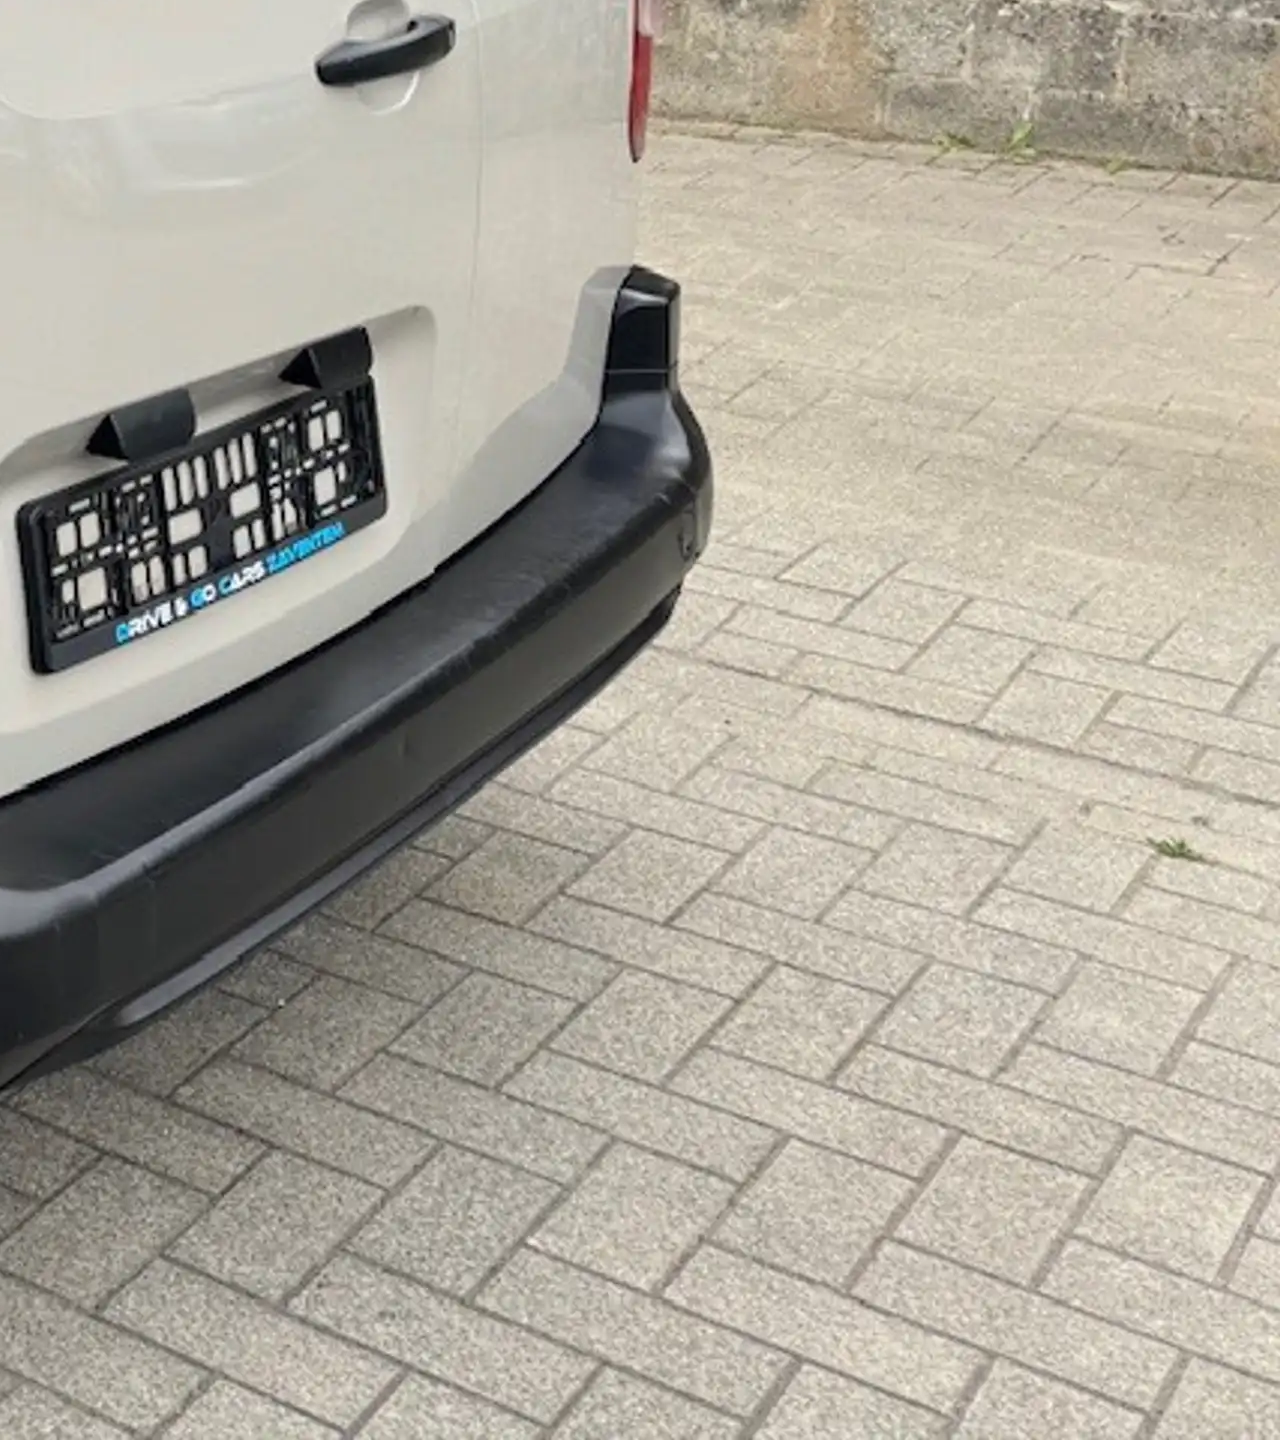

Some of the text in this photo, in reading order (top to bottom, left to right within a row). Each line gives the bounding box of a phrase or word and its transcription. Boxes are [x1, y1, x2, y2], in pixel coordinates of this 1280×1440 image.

[115, 603, 173, 644] DRIVE
[190, 583, 217, 608] GO
[218, 560, 266, 595] CARS
